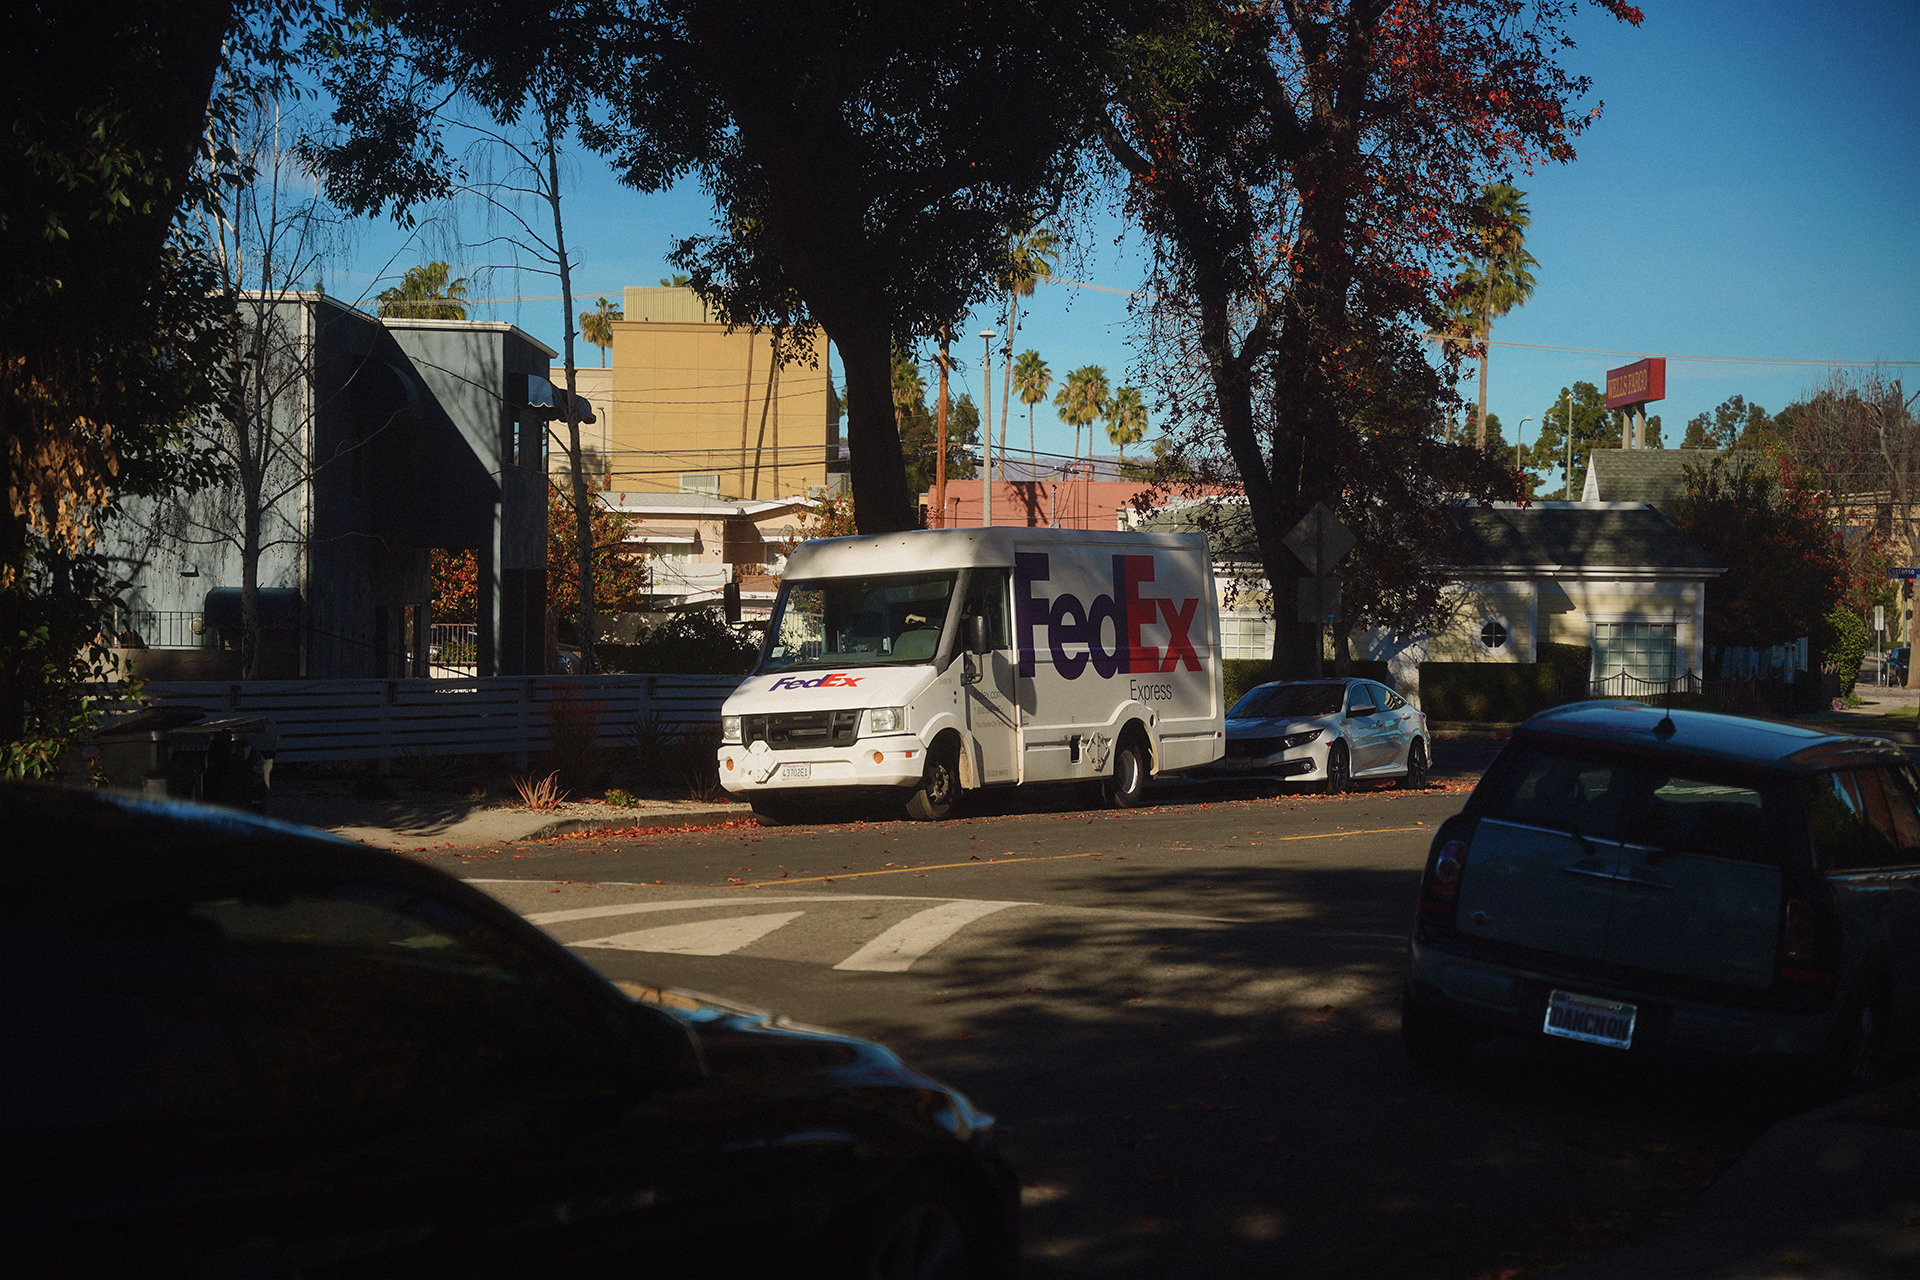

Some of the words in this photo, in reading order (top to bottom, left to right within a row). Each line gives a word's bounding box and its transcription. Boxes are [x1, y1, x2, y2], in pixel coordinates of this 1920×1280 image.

[1607, 376, 1628, 400] WELLS
[1627, 369, 1647, 395] FARGO
[1014, 552, 1203, 680] FedEx
[768, 673, 866, 692] FedEx
[1129, 679, 1173, 705] Express
